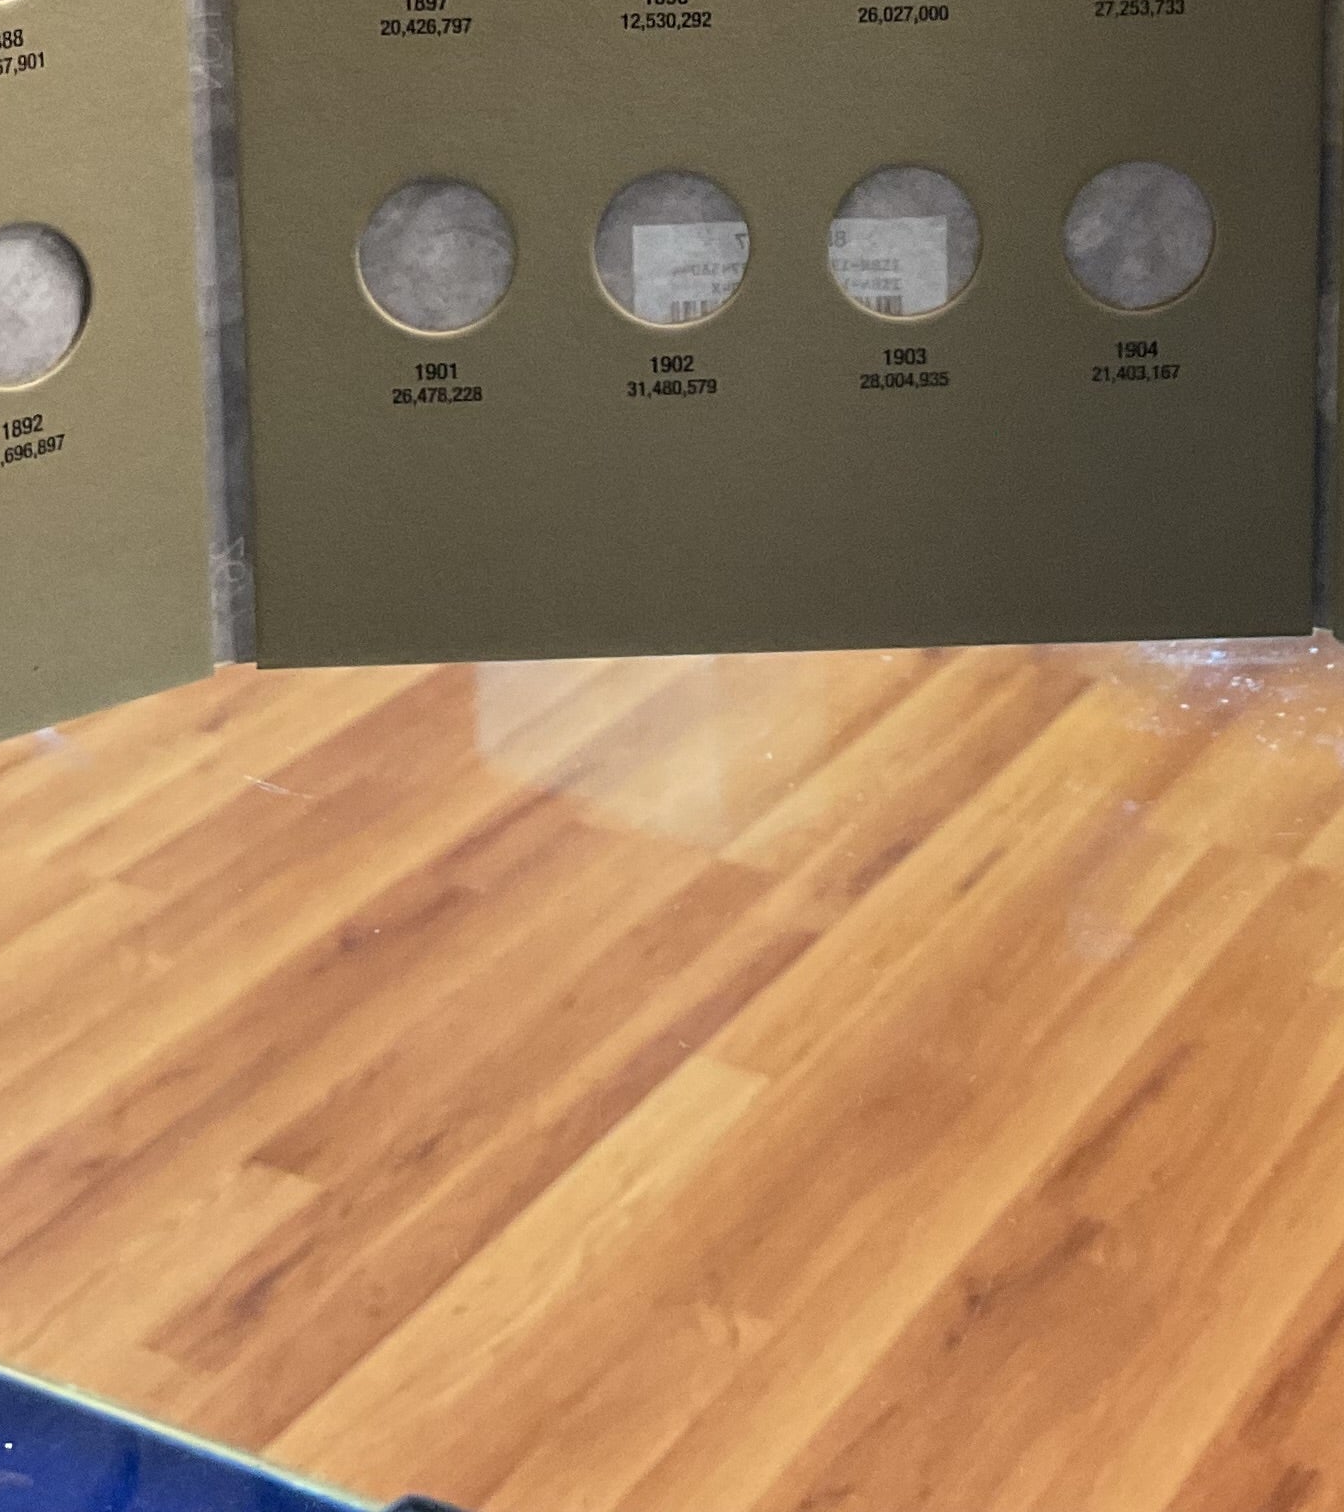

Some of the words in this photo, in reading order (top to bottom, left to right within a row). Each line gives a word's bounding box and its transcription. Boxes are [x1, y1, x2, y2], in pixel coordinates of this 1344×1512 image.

[857, 5, 950, 26] 26,027,000
[1094, 0, 1186, 20] 27,253,733
[379, 18, 472, 39] 20,426,797
[620, 12, 713, 33] 12,530,292
[882, 348, 927, 367] 1903
[1114, 341, 1159, 360] 1904
[413, 362, 458, 381] 1901
[650, 355, 695, 374] 1902
[626, 379, 718, 399] 31,480,579
[859, 372, 950, 392] 28,004,935
[391, 387, 484, 407] 26,478,228
[3, 414, 45, 440] 1892
